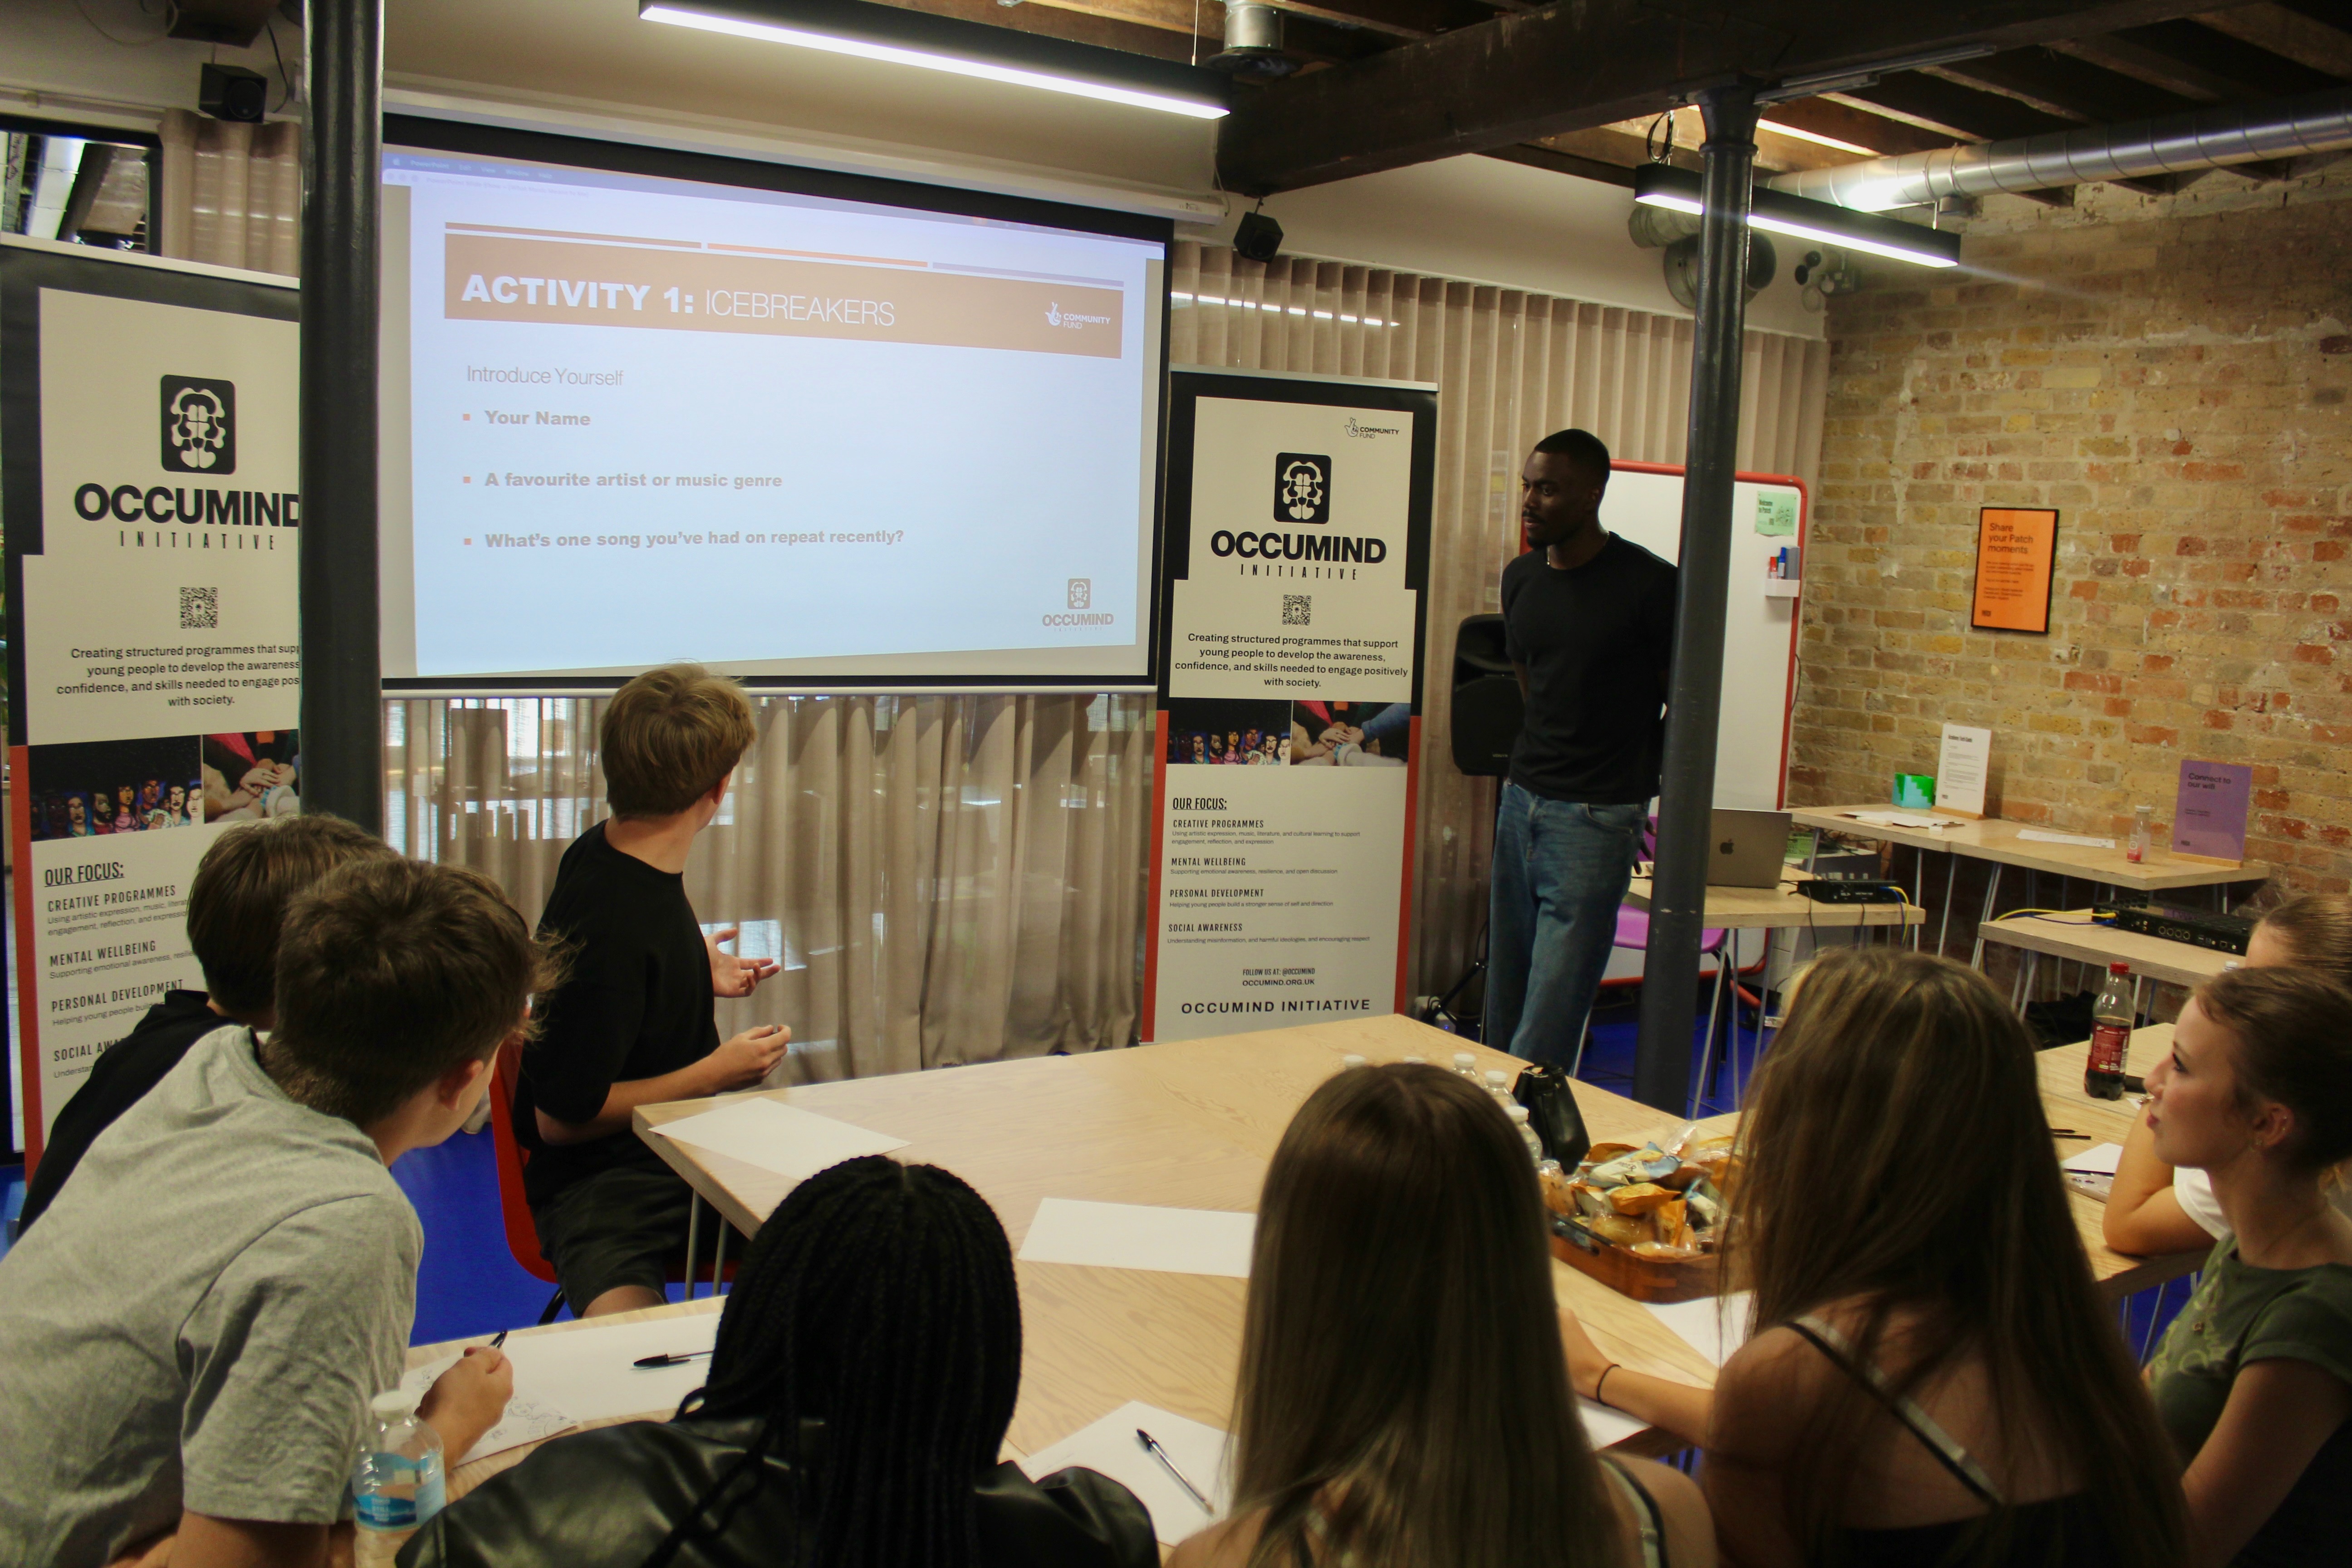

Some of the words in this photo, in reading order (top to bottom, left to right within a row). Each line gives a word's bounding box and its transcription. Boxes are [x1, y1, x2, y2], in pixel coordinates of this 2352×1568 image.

[461, 274, 651, 310] ACTIVITY
[663, 287, 693, 313] 1:
[706, 289, 894, 326] ICEBREAKERS
[1063, 313, 1110, 324] COMMUNITY
[467, 365, 551, 383] Introduce
[554, 368, 623, 385] Yourself
[484, 410, 529, 424] Your
[536, 411, 590, 425] Name
[484, 472, 499, 486] A
[505, 472, 590, 486] favourite
[596, 473, 646, 486] artist
[652, 476, 671, 486] or
[676, 473, 728, 486] music
[734, 477, 782, 490] genre
[1989, 522, 2013, 532] Share
[120, 531, 273, 549] INITIATIVE
[485, 533, 550, 547] What’s
[556, 536, 591, 546] one
[597, 535, 640, 548] song
[646, 531, 702, 548] you’ve
[708, 531, 739, 544] had
[745, 534, 765, 543] on
[771, 530, 824, 546] repeat
[830, 530, 903, 545] recently?
[1211, 530, 1386, 563] OCCUMIND
[2009, 534, 2033, 543] Patch
[1988, 545, 2027, 554] moments
[1241, 564, 1356, 580] INITIATIVE
[1042, 613, 1114, 626] OCCUMIND
[1188, 633, 1229, 644] Creating
[1231, 635, 1280, 643] structured
[1282, 638, 1341, 646] programmes
[71, 647, 123, 659] Creating
[126, 646, 183, 657] structured
[186, 647, 255, 657] programmes
[257, 644, 276, 653] that
[1200, 649, 1229, 658] young
[1231, 649, 1263, 658] people
[1277, 650, 1314, 660] develop
[1316, 651, 1331, 659] the
[87, 666, 124, 677] young
[127, 663, 165, 676] people
[181, 662, 224, 672] develop
[227, 662, 244, 670] the
[1175, 661, 1230, 671] confidence,
[1254, 663, 1278, 671] skills
[1280, 664, 1314, 672] needed
[1328, 667, 1362, 676] engage
[1364, 667, 1407, 677] positively
[57, 683, 127, 694] confidence,
[131, 681, 152, 691] and
[155, 680, 182, 690] skills
[186, 678, 225, 688] needed
[242, 678, 279, 688] engage
[1286, 678, 1320, 688] society.
[168, 696, 190, 706] with
[193, 695, 234, 706] society.
[2188, 772, 2221, 783] Connect
[1173, 798, 1191, 809] OUR
[1195, 798, 1226, 809] FOCUS:
[1173, 819, 1208, 828] CREATIVE
[45, 867, 73, 887] OUR
[78, 862, 124, 882] FOCUS:
[48, 895, 98, 911] CREATIVE
[104, 885, 175, 904] PROGRAMMES
[48, 916, 70, 924] Using
[71, 912, 97, 921] artistic
[99, 906, 140, 916] expression,
[48, 923, 98, 936] engagement,
[100, 919, 136, 928] reflection,
[138, 915, 152, 923] and
[50, 950, 92, 966] MENTAL
[98, 941, 155, 959] WELLBEING
[49, 967, 92, 979] Supporting
[93, 960, 130, 972] emotional
[132, 955, 172, 965] awareness,
[1282, 968, 1315, 976] @OCCUMIND
[52, 993, 107, 1012] PERSONAL
[1181, 1001, 1274, 1013] OCCUMIND
[1282, 1000, 1369, 1011] INITIATIVE
[53, 1016, 82, 1025] Helping
[84, 1011, 107, 1020] young
[109, 1007, 133, 1016] people
[54, 1044, 91, 1061] SOCIAL
